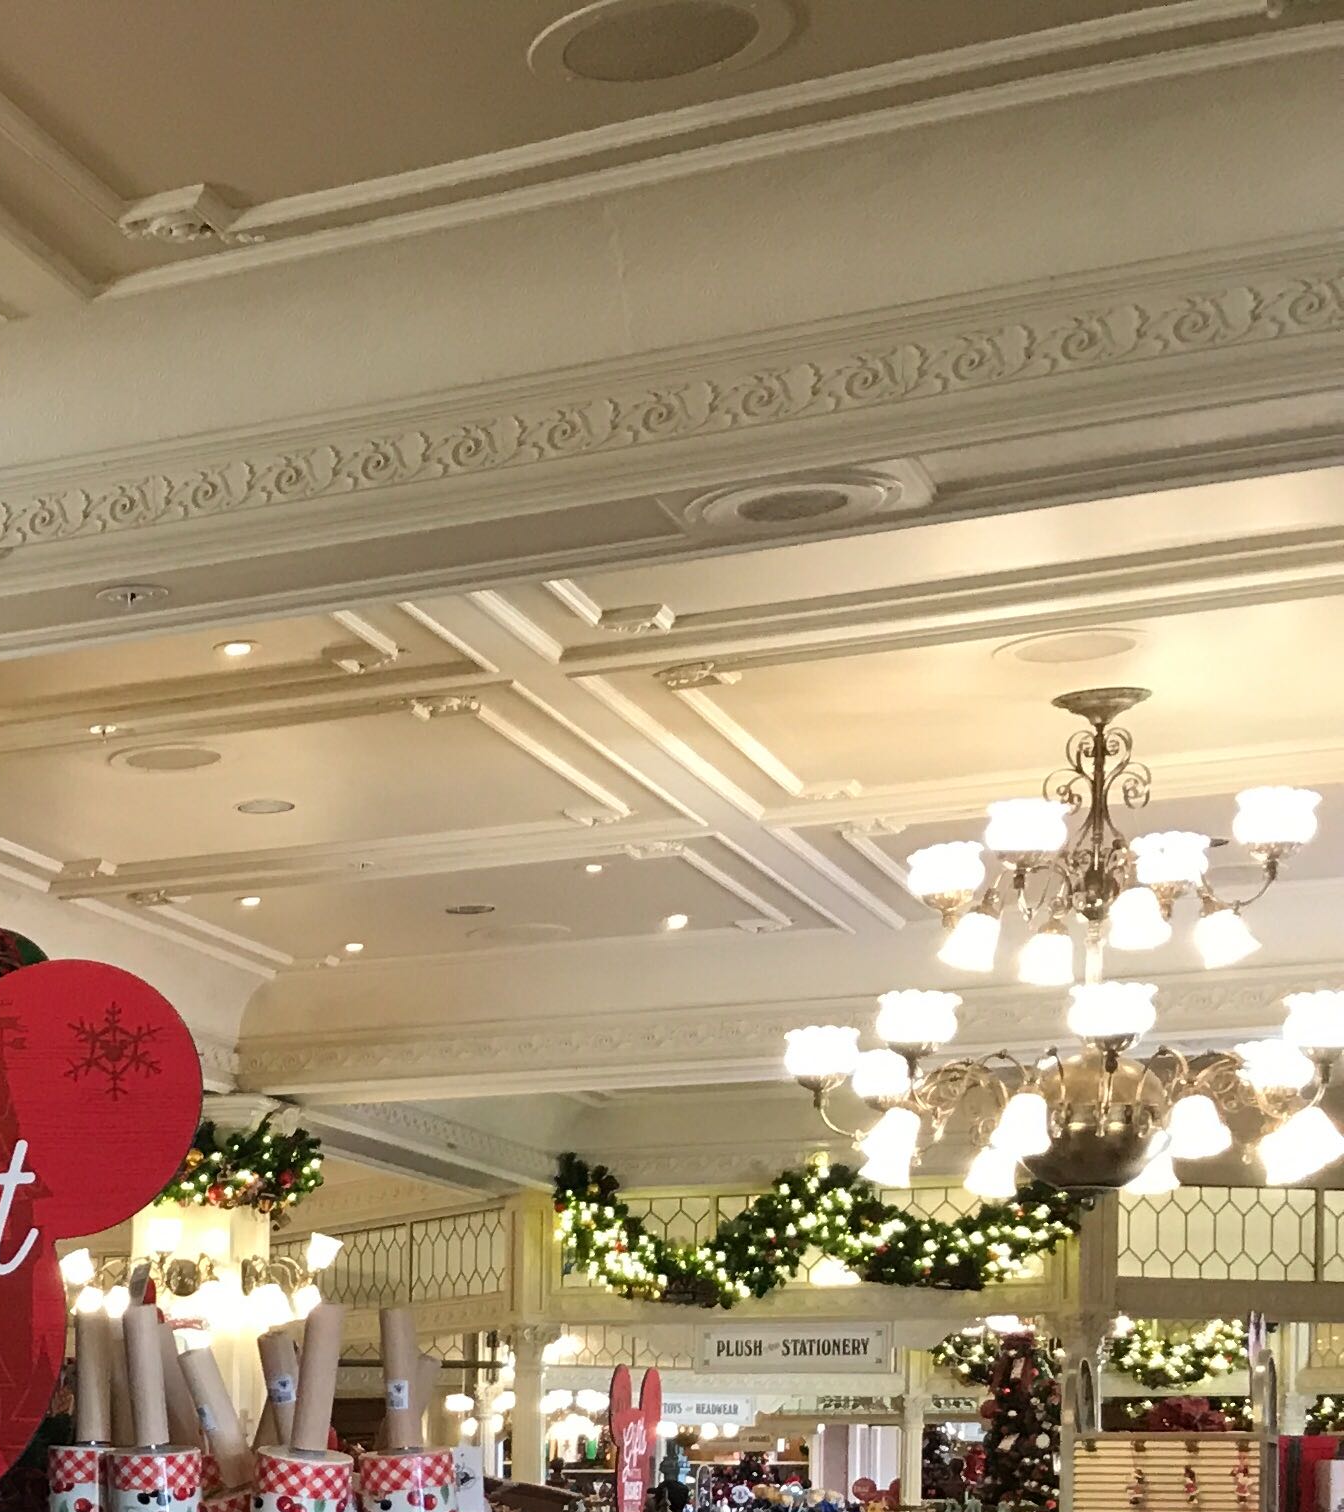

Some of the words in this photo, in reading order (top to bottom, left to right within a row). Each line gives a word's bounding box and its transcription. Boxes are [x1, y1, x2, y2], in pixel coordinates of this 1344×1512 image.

[716, 1340, 762, 1357] PLUSH
[781, 1338, 870, 1356] STATIONERY
[695, 1403, 739, 1415] HEADWEAR
